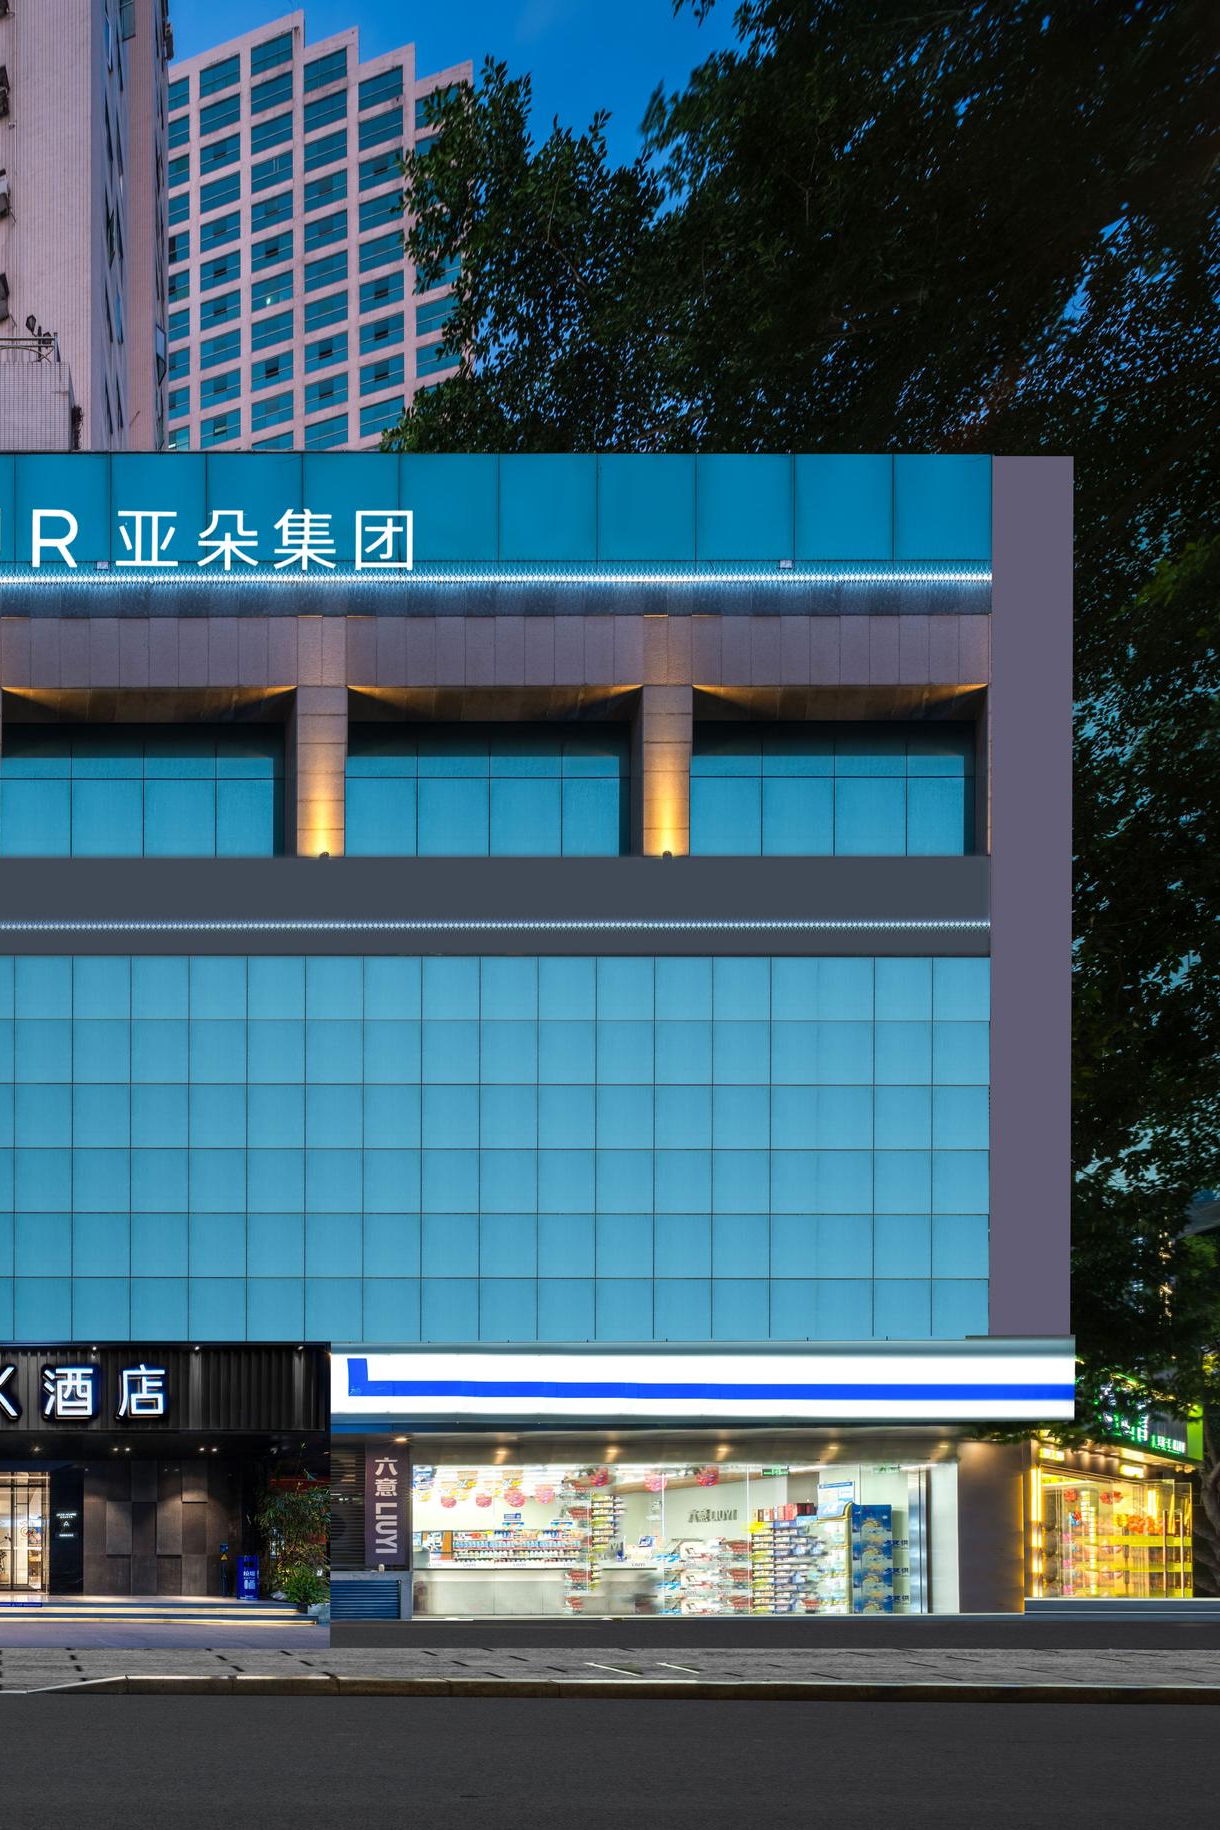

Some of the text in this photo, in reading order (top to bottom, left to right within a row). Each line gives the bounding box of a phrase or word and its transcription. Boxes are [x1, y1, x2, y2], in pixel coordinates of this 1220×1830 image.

[115, 508, 414, 571] 亚朵集团
[374, 1457, 398, 1554] 六意 LIUYI
